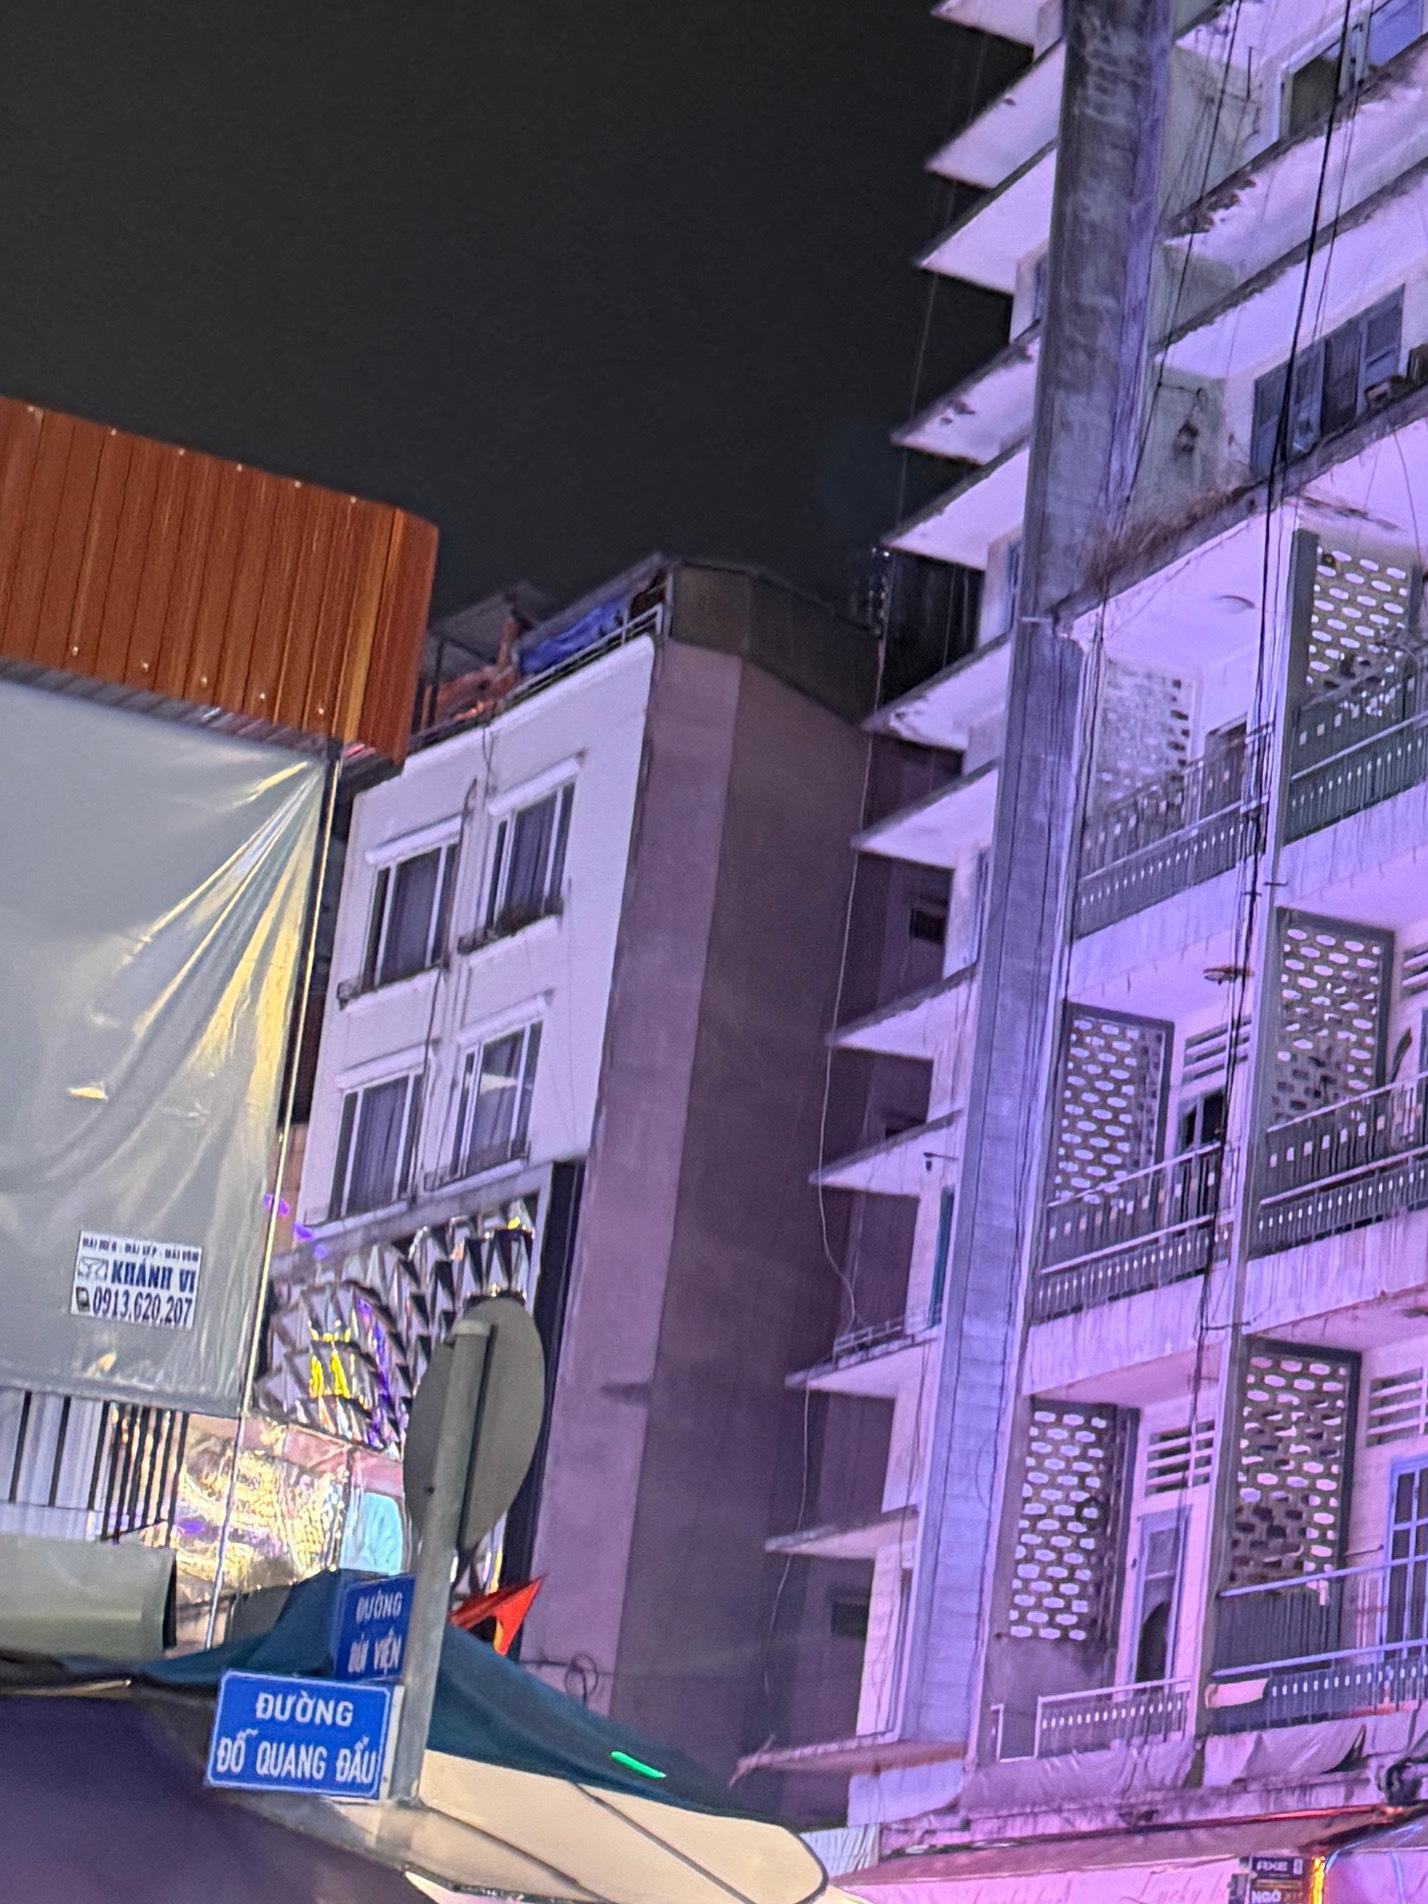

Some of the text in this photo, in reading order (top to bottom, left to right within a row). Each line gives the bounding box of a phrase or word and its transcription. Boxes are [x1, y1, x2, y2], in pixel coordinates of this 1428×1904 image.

[111, 1257, 173, 1290] KHÁNH
[256, 1691, 354, 1727] ĐƯỜNG
[216, 1728, 259, 1774] ĐỖ
[256, 1740, 327, 1780] QUANG
